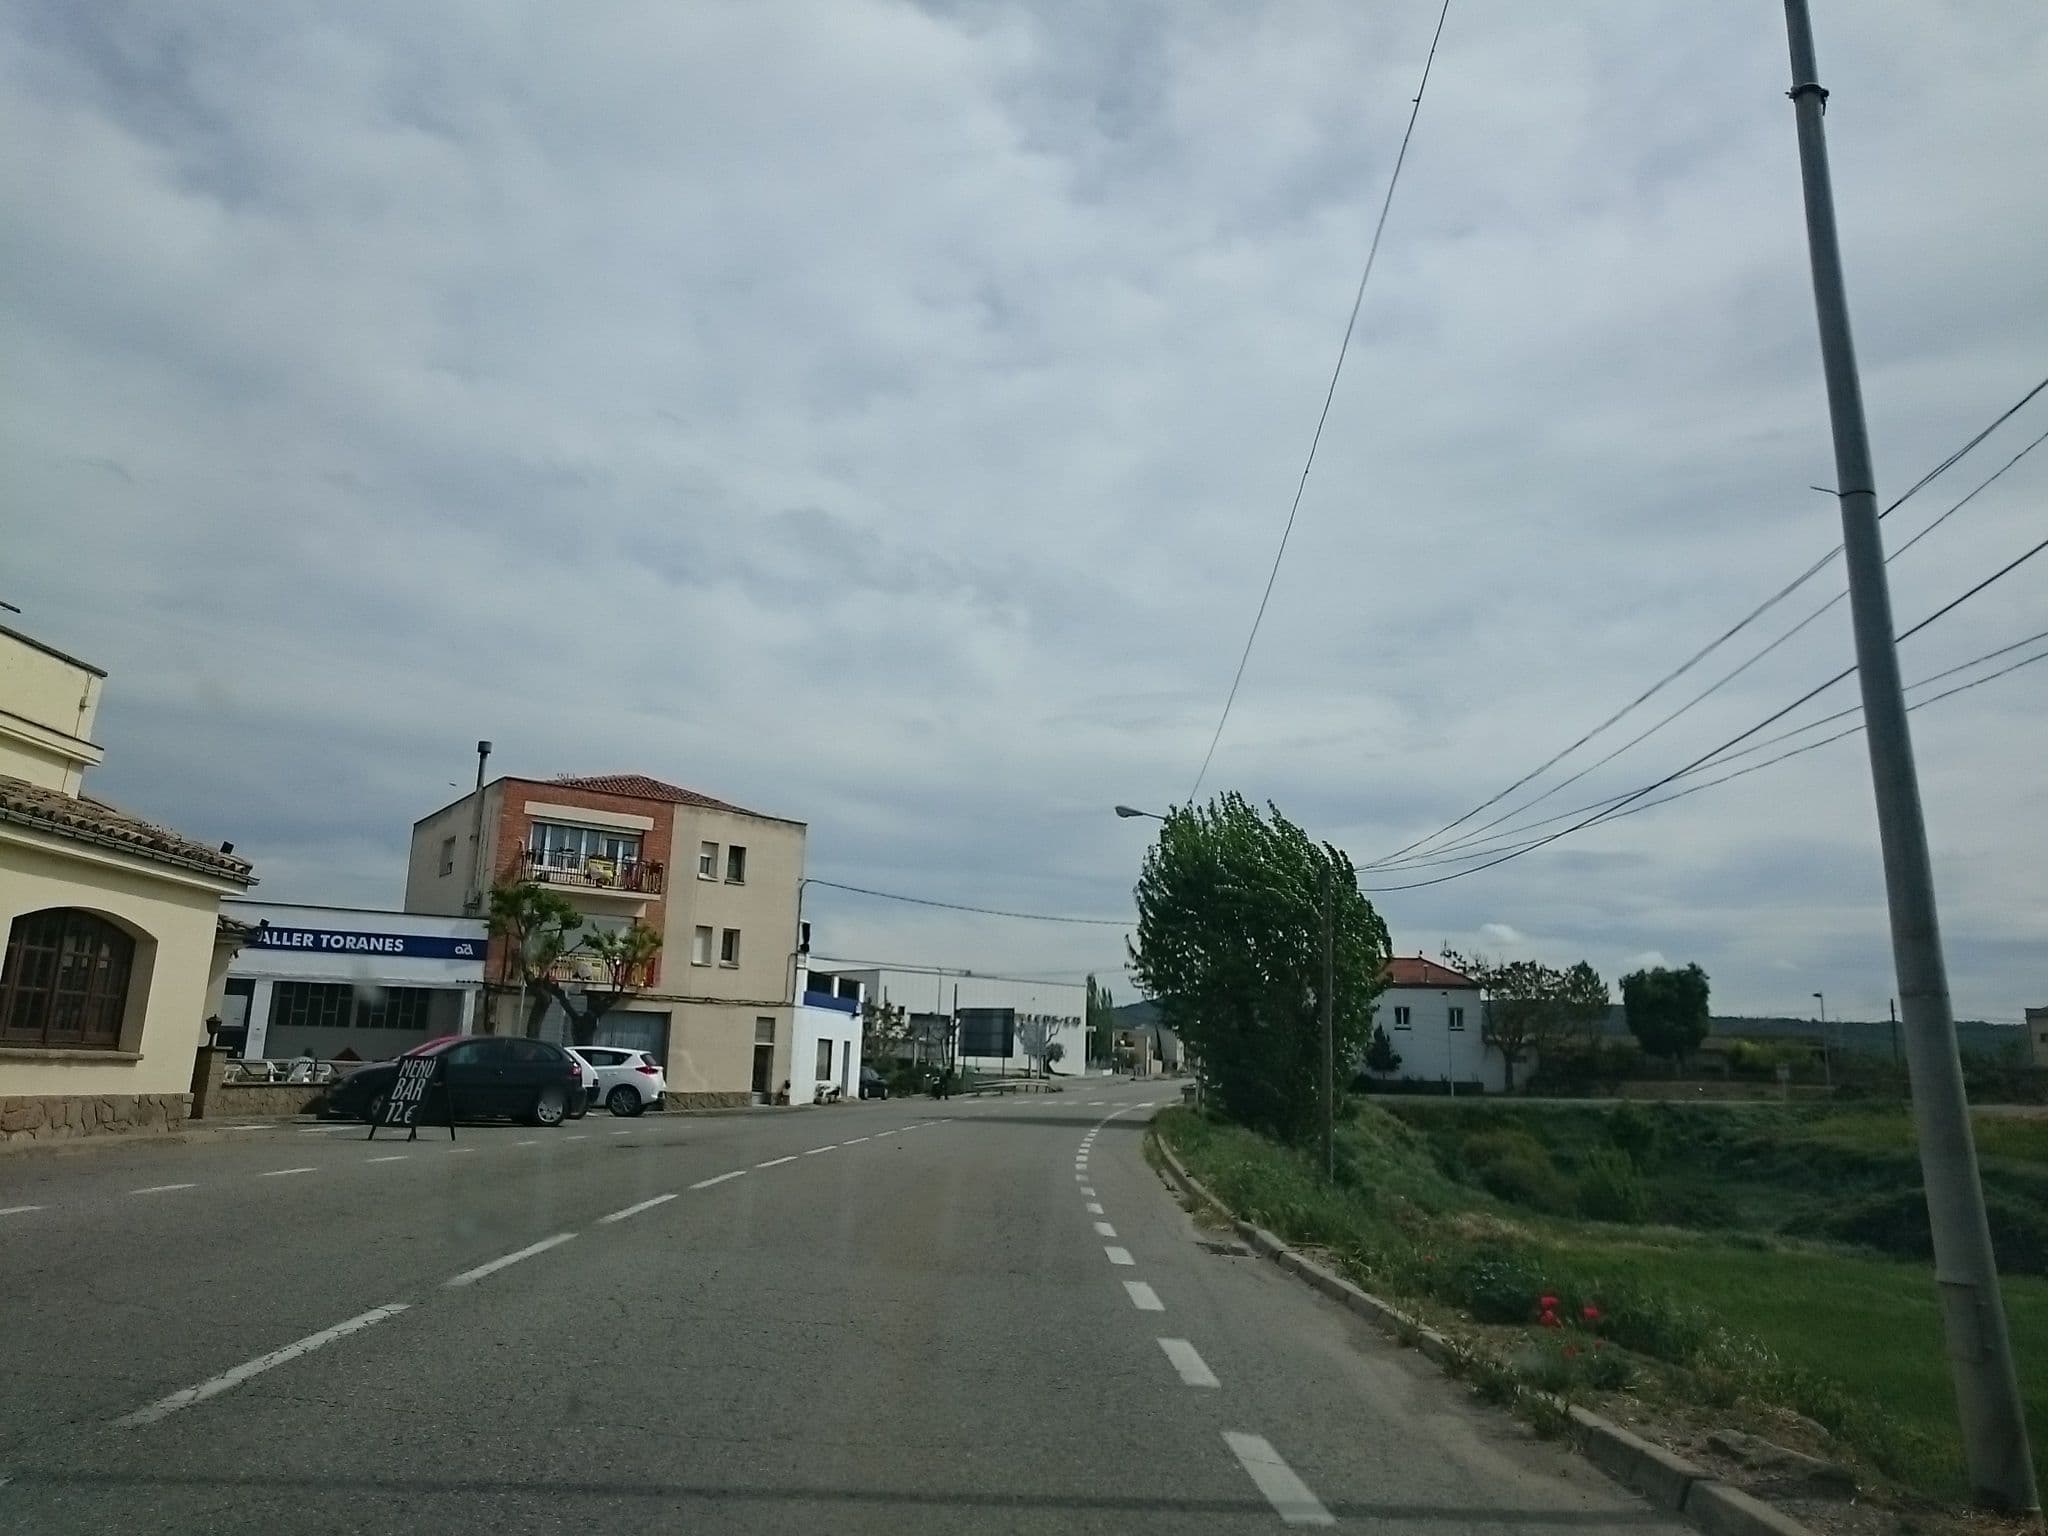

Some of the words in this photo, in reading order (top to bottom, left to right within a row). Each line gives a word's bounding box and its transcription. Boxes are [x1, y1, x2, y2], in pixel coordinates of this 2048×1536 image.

[258, 930, 313, 947] ALLER
[320, 934, 404, 952] TORANES
[391, 1077, 426, 1101] BAR
